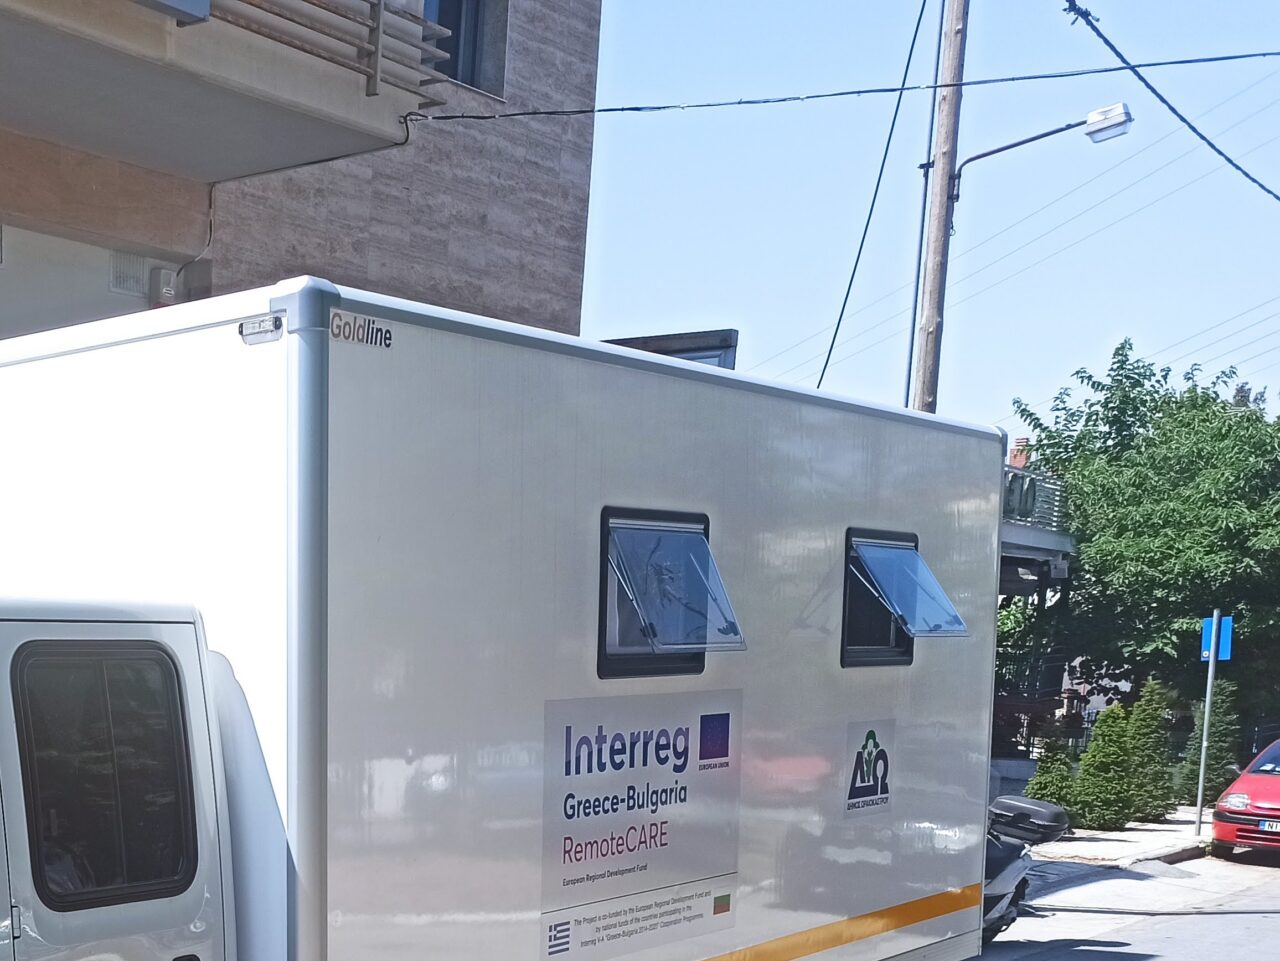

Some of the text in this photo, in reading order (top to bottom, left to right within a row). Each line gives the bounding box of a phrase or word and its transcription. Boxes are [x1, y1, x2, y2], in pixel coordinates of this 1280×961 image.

[331, 312, 392, 348] Goldline
[564, 724, 690, 776] Interreg
[563, 779, 687, 820] Greece-Bulgaria
[562, 821, 668, 865] RemoteCARE
[562, 863, 648, 886] European Regional Development Fund
